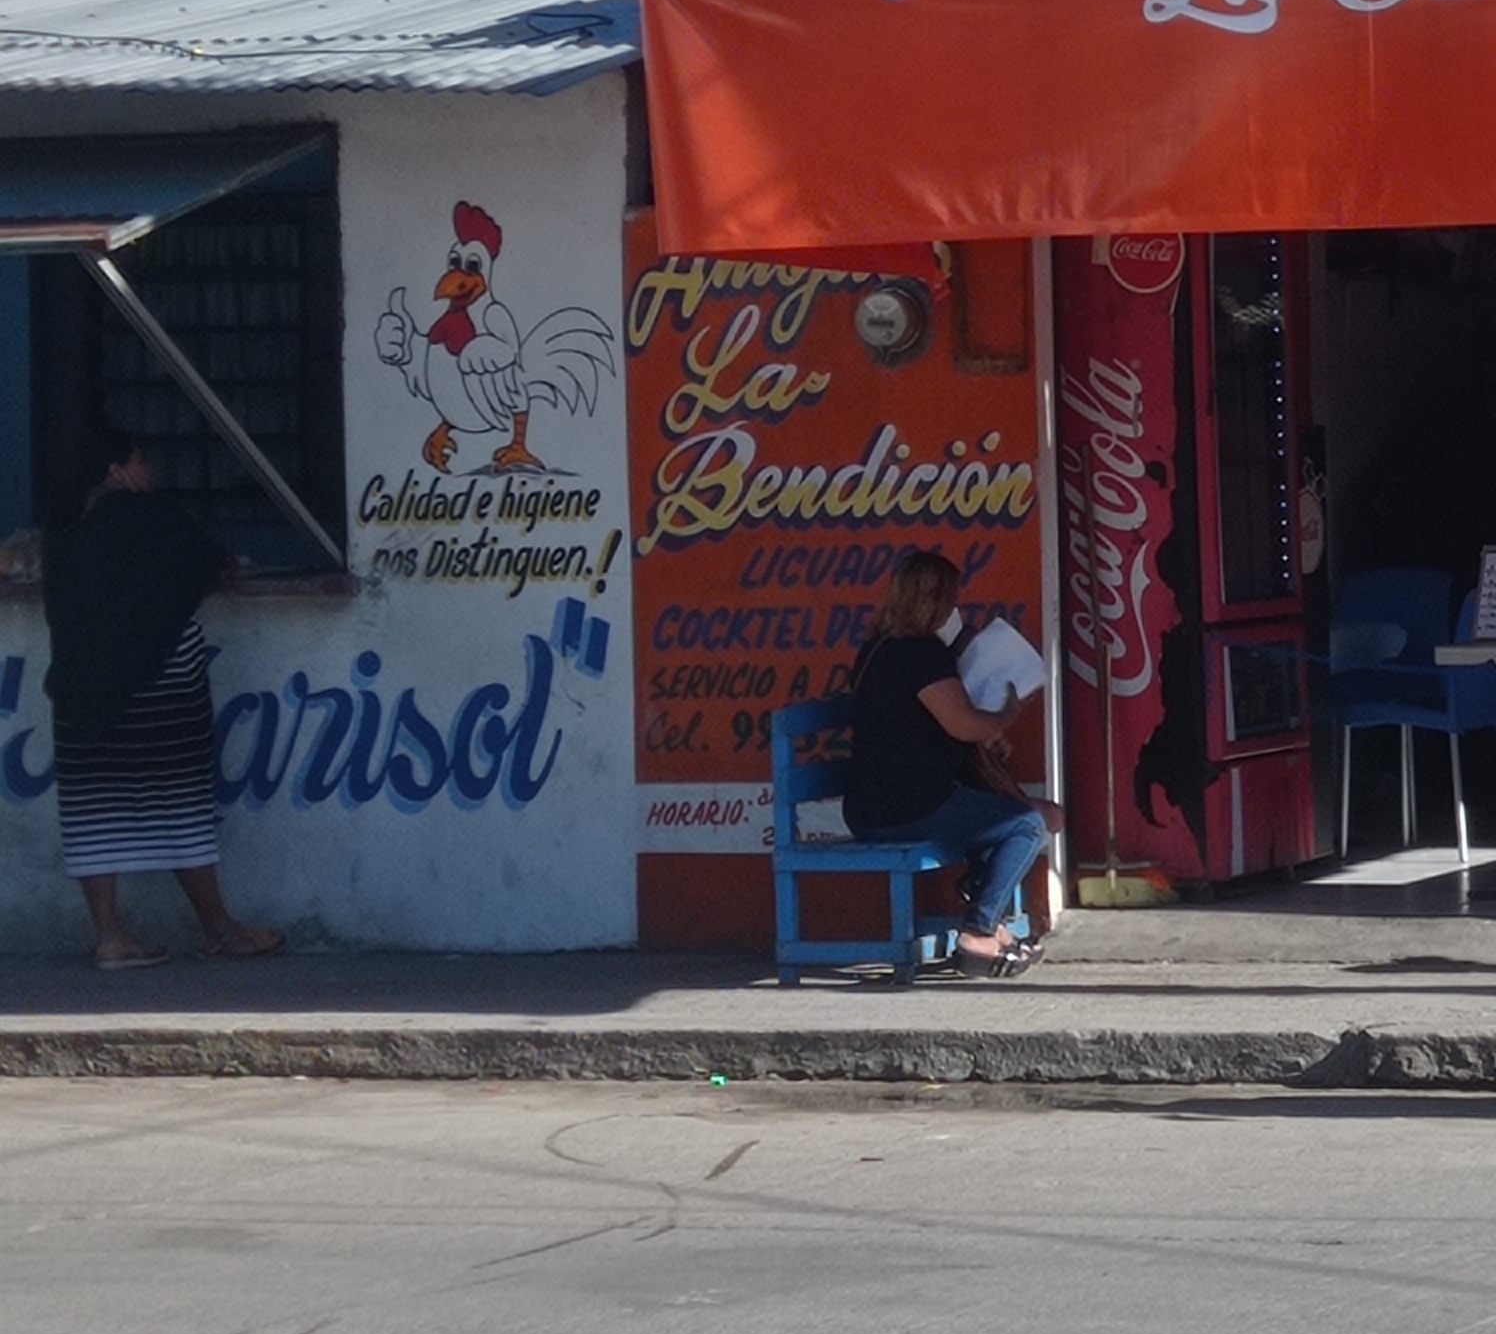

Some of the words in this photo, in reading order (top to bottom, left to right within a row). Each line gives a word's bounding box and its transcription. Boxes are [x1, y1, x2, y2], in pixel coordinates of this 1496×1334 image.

[665, 304, 831, 435] La
[358, 468, 478, 524] Calidad
[475, 488, 494, 518] e
[497, 475, 602, 533] higiene
[637, 420, 1038, 556] Bendición
[372, 546, 419, 579] nos
[959, 541, 997, 587] Y
[652, 604, 816, 652] COCKTEL
[824, 603, 870, 649] DE
[648, 659, 778, 702] SERVICIO
[787, 661, 812, 700] A
[645, 711, 710, 754] Cel.
